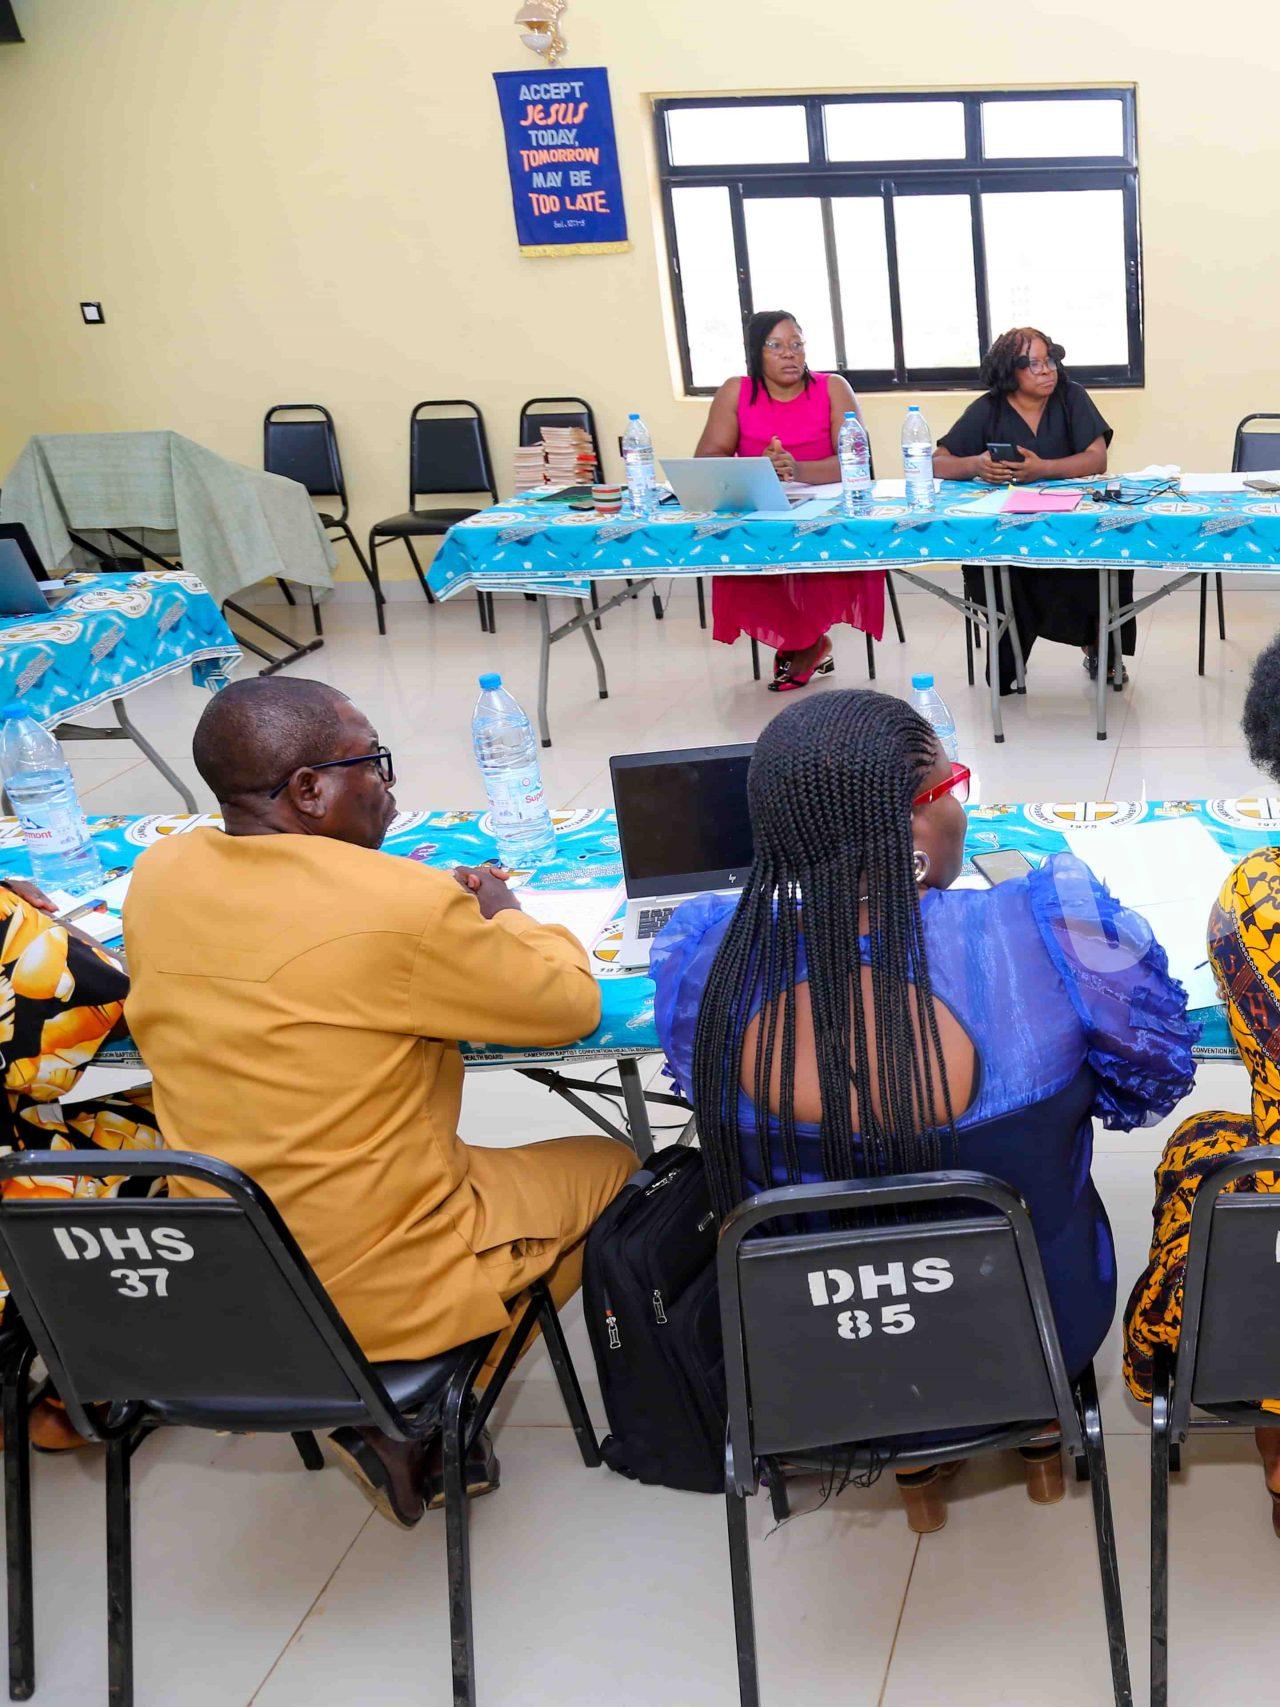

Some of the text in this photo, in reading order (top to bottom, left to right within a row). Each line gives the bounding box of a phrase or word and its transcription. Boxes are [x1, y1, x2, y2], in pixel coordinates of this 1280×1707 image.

[519, 81, 584, 101] ACCEPT
[520, 102, 589, 126] JESUS
[528, 129, 579, 147] TODAY,
[519, 147, 600, 172] TOMORROW
[532, 170, 592, 189] MAY BE
[528, 192, 561, 217] TOO
[1192, 1046, 1228, 1054] CONVENTION
[52, 1226, 195, 1262] DHS
[109, 1267, 171, 1298] 37
[807, 1257, 955, 1306] DHS
[836, 1302, 917, 1339] 85
